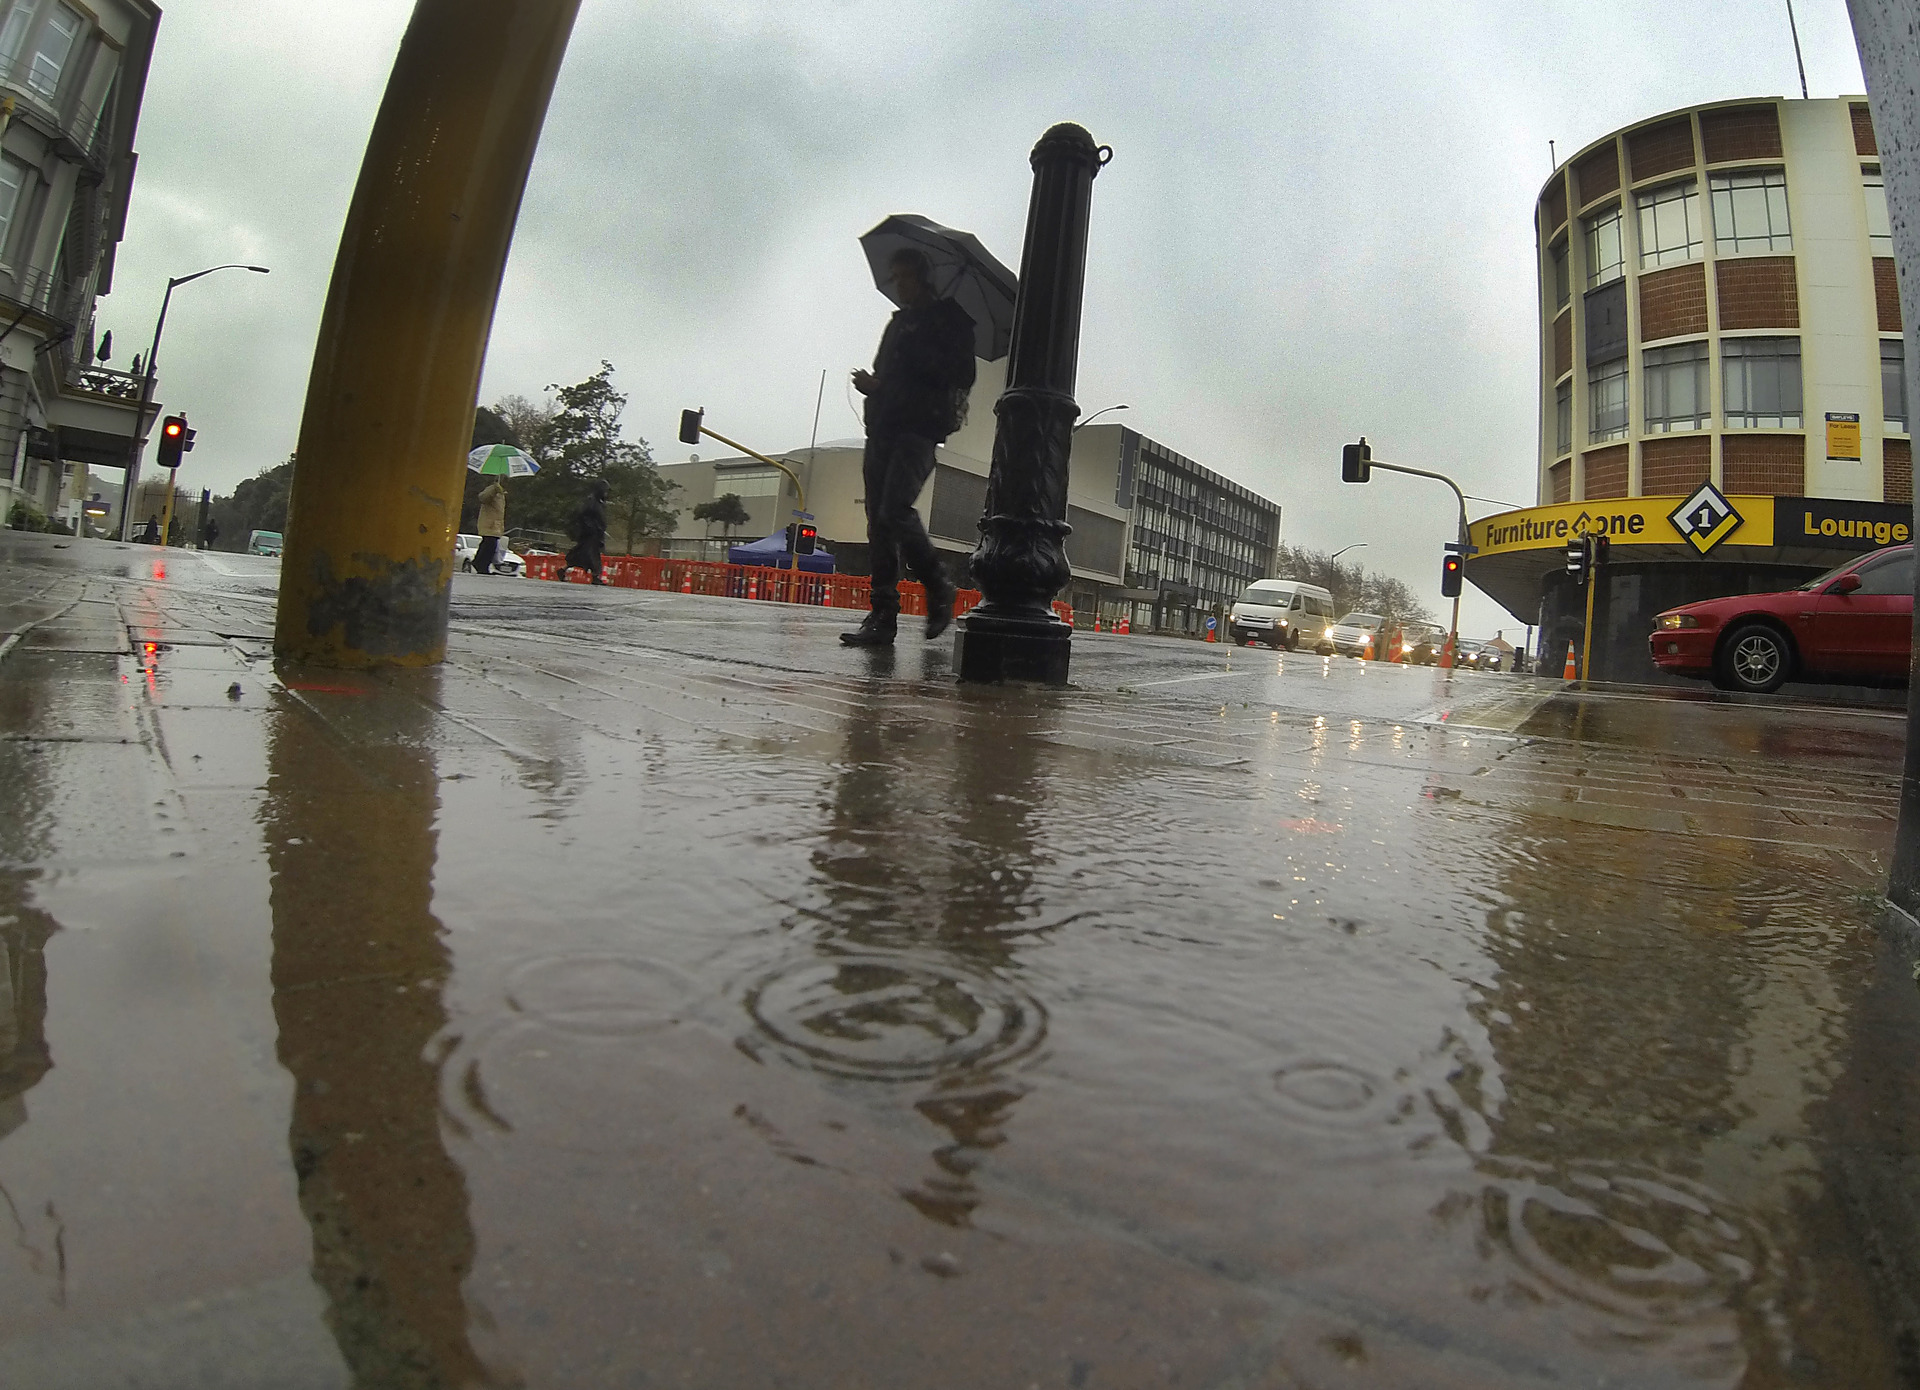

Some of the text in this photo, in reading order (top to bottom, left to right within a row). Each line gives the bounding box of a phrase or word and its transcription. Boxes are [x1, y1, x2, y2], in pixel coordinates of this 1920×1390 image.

[1486, 518, 1568, 546] Furniture
[1595, 513, 1645, 535] one
[1698, 508, 1711, 528] 1
[1804, 512, 1909, 544] Lounge
